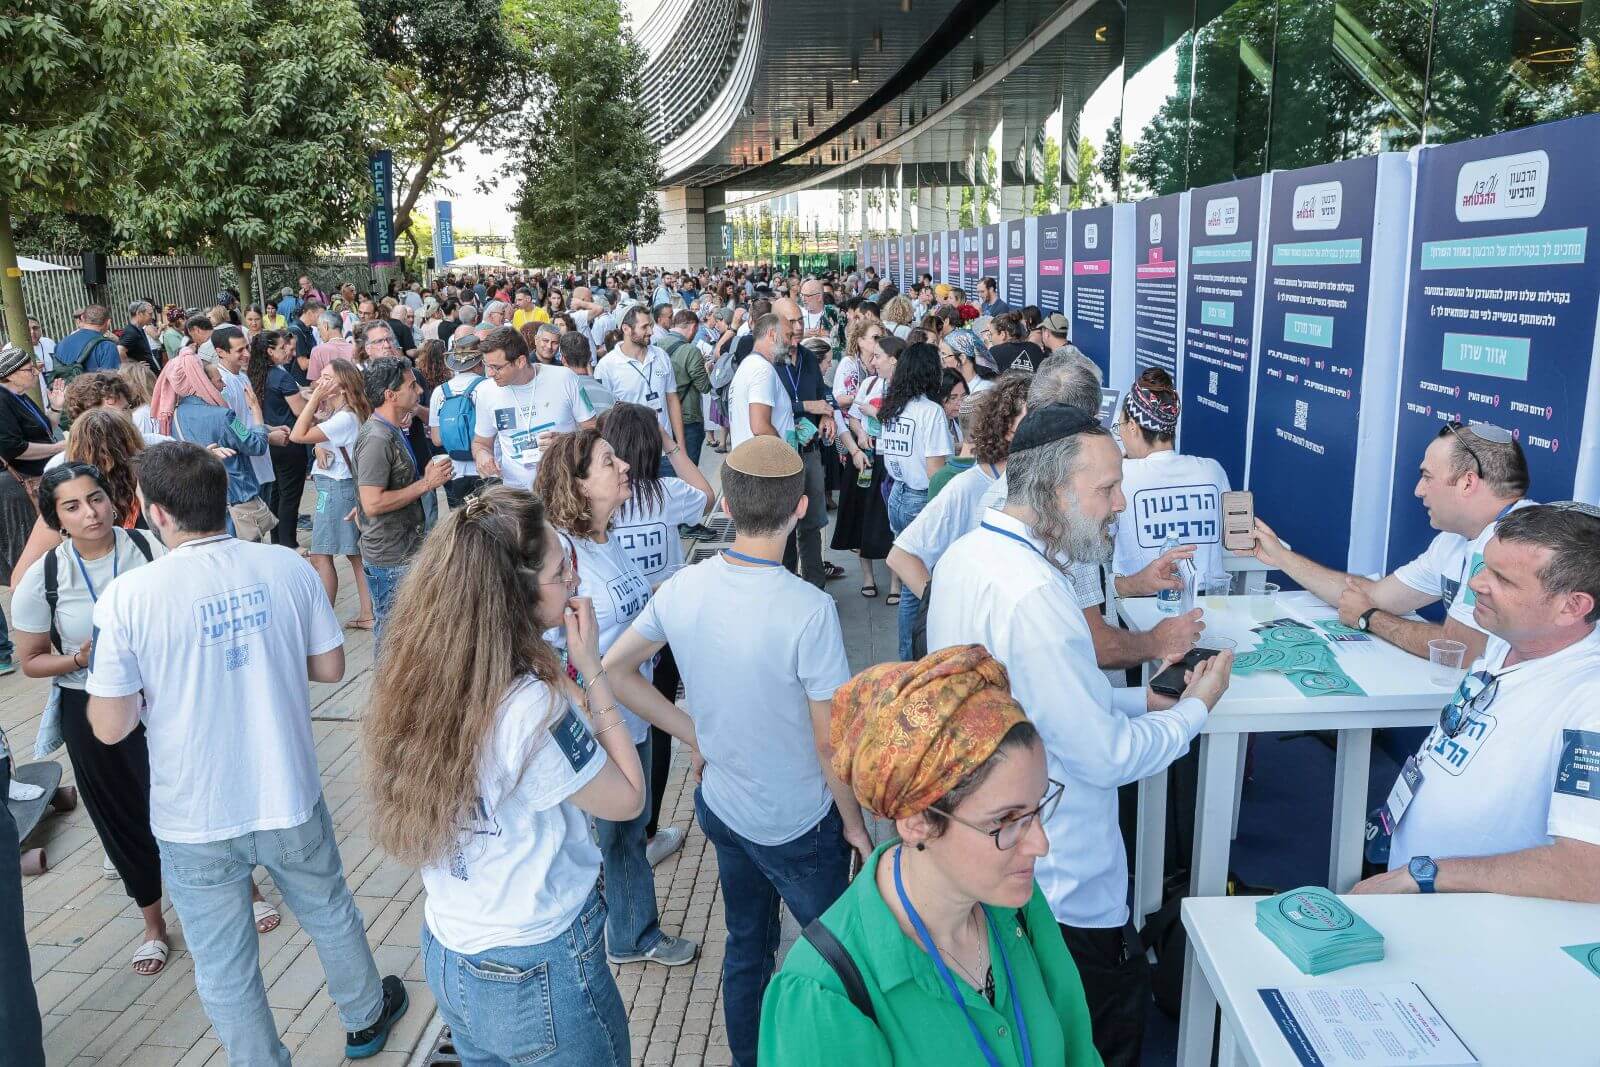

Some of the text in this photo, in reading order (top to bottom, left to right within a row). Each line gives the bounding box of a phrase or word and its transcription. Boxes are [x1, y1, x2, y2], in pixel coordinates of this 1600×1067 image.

[1510, 169, 1537, 187] הרבעון
[1463, 192, 1496, 207] ההבטחה
[1508, 186, 1535, 200] הרביעי
[377, 210, 389, 254] הבאים
[1472, 245, 1495, 260] הרבעון
[1496, 245, 1506, 257] של
[1509, 244, 1540, 259] בקהילות
[1543, 243, 1551, 258] לך
[1553, 243, 1581, 256] מחכים
[1465, 286, 1474, 298] על
[1474, 287, 1504, 301] להתעדכן
[1504, 289, 1518, 302] ניתן
[1519, 289, 1536, 301] שלנו
[1538, 289, 1571, 305] בקהילות
[1436, 305, 1443, 318] לך
[1443, 308, 1469, 320] שמתאים
[1469, 310, 1479, 321] מה
[1479, 310, 1492, 322] לפי
[1492, 311, 1518, 324] בעשייה
[1518, 312, 1556, 327] ולהשתתף
[1459, 342, 1508, 365] אזור שרון
[1480, 394, 1493, 405] ראש
[1510, 401, 1545, 417] דרום השרון
[1528, 434, 1551, 449] שומרון
[1142, 493, 1216, 519] הרבעון
[1143, 520, 1216, 540] הרביעי
[200, 590, 265, 622] הרבעון
[202, 610, 267, 639] הרביעי
